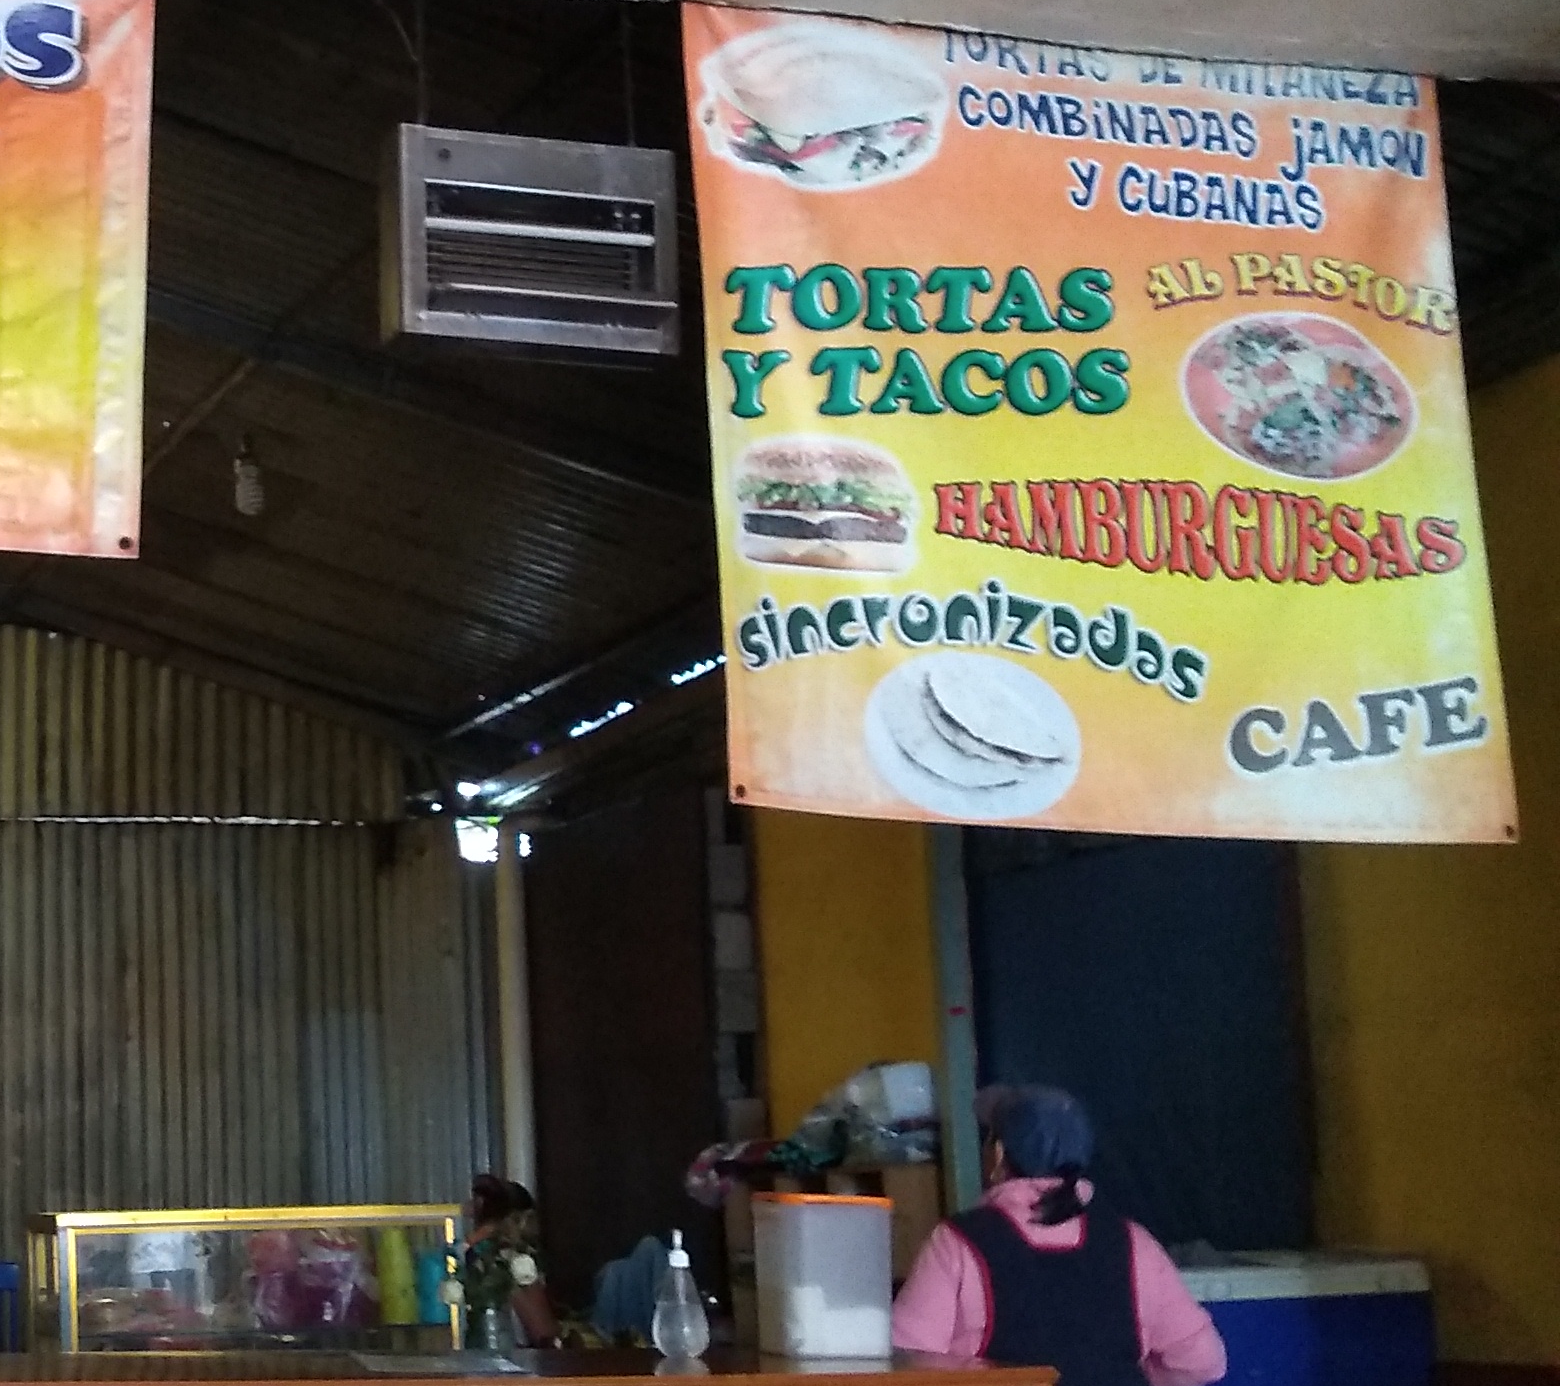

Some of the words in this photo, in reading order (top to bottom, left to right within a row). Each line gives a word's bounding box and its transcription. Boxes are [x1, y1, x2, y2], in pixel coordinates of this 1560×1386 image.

[725, 265, 1116, 334] TORTAS
[1146, 257, 1225, 311] AL
[1229, 252, 1458, 336] PASTOR
[722, 349, 790, 418] Y
[810, 348, 1131, 418] TACOS
[933, 477, 1467, 587] HAMBURGUESAS
[736, 579, 1206, 702] sincronizadas
[1228, 678, 1487, 774] CAFE
